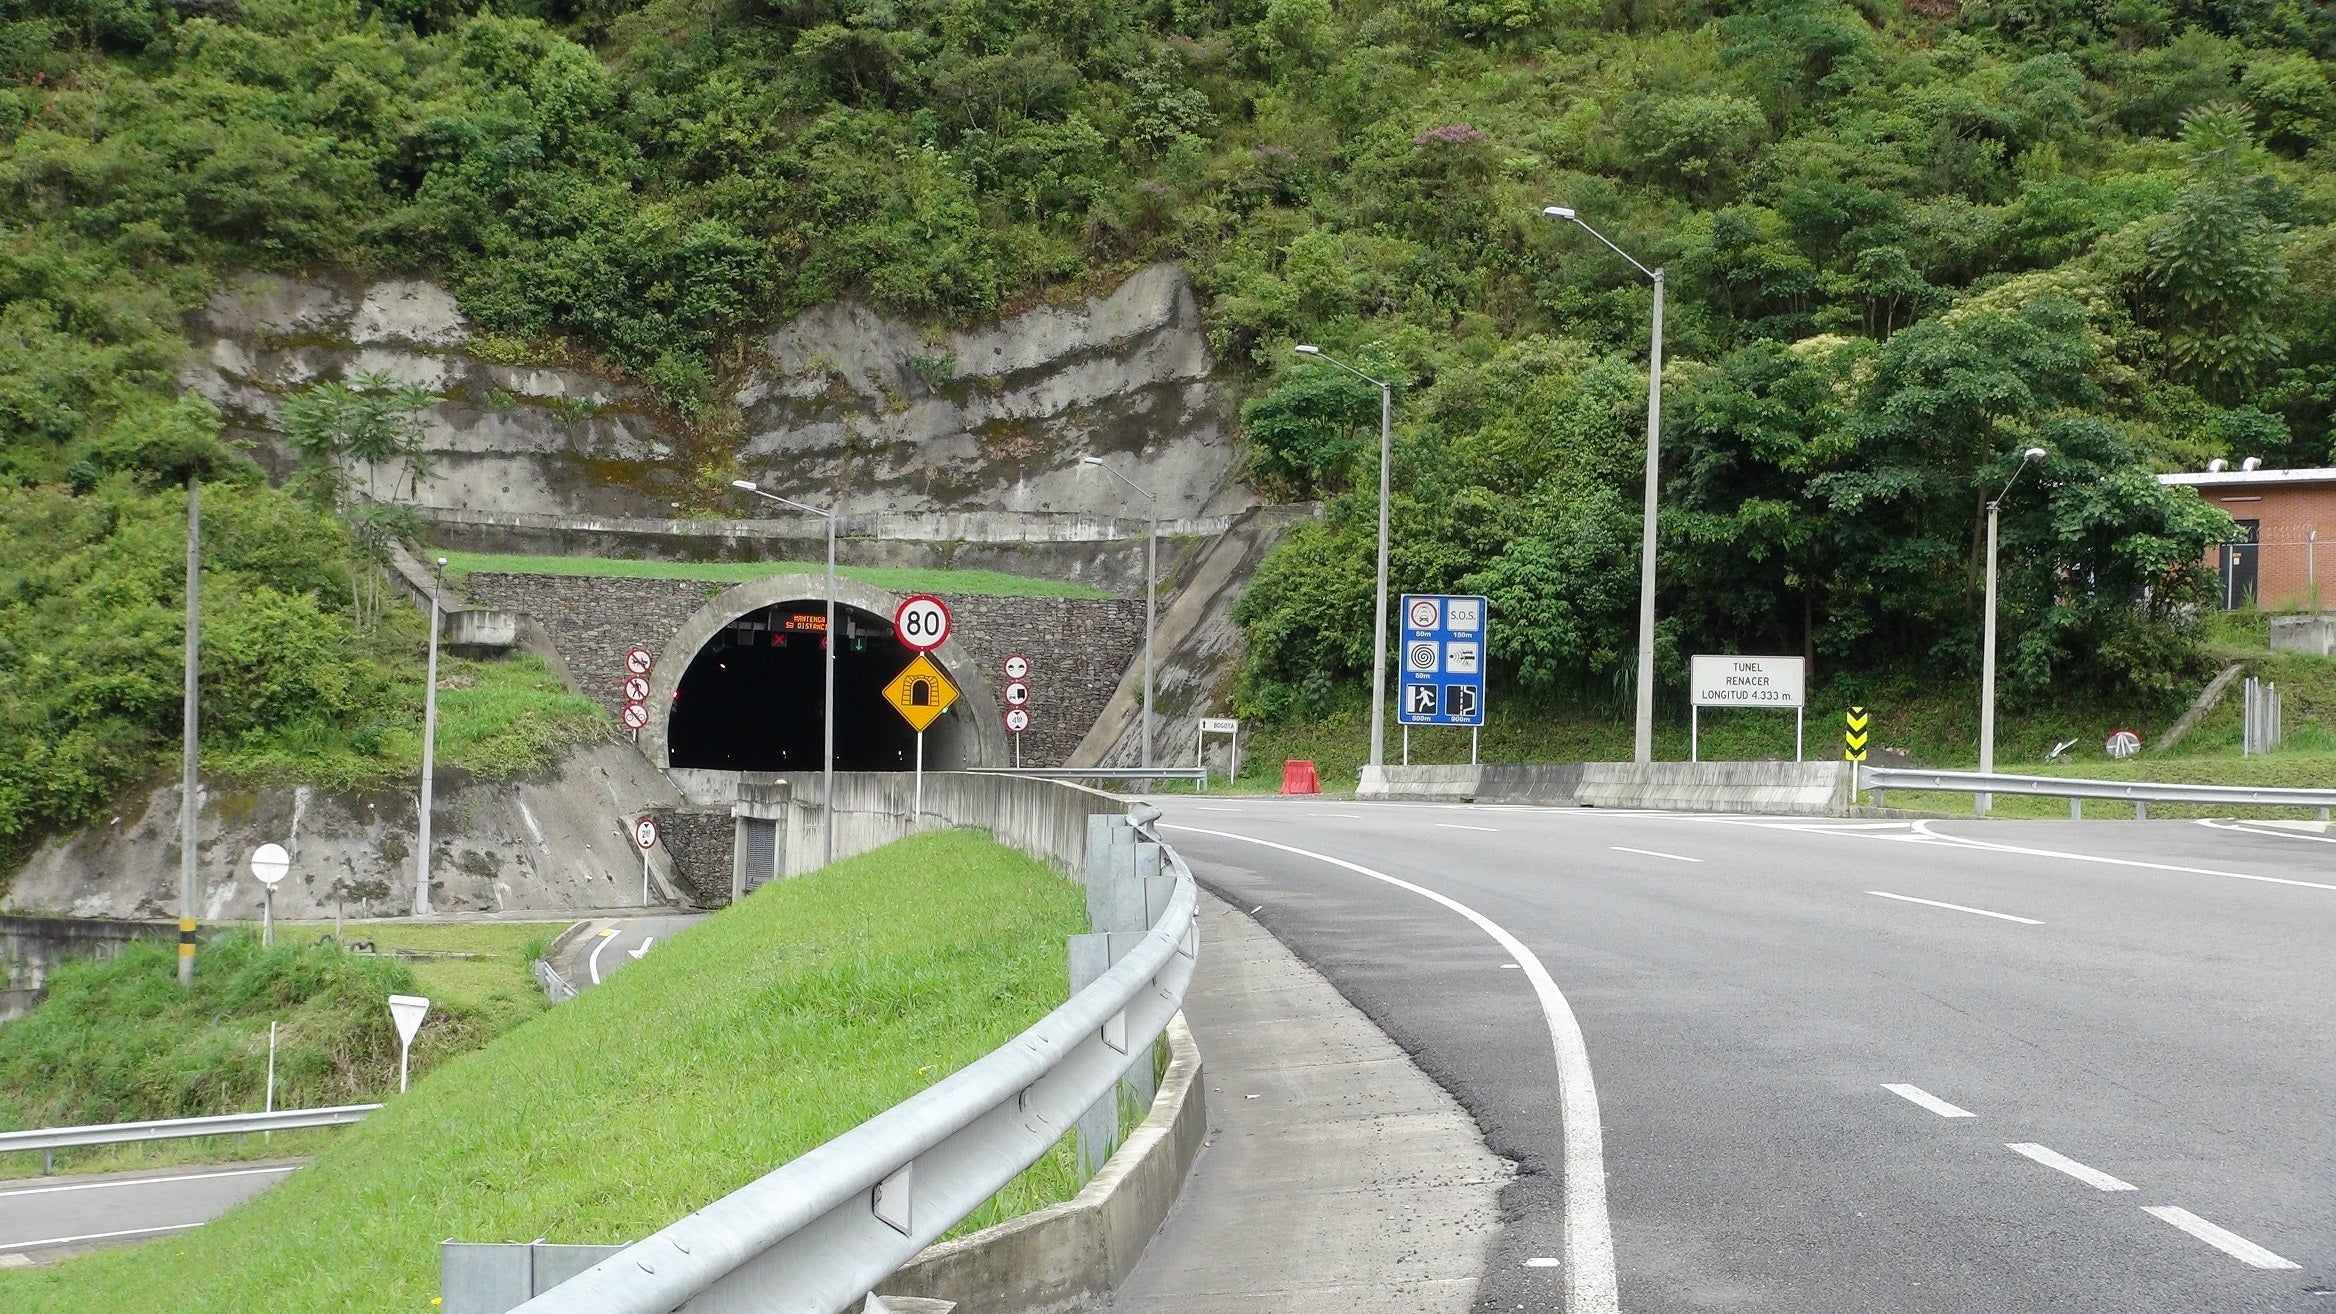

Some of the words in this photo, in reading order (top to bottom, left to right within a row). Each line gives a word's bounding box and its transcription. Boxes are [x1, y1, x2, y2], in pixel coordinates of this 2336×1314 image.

[1450, 610, 1476, 620] S.O.S.
[907, 611, 939, 636] 80
[1733, 662, 1763, 672] TUNEL
[1726, 676, 1770, 686] RENACER
[1701, 690, 1749, 700] LONGITUD
[1751, 691, 1779, 700] 4.333
